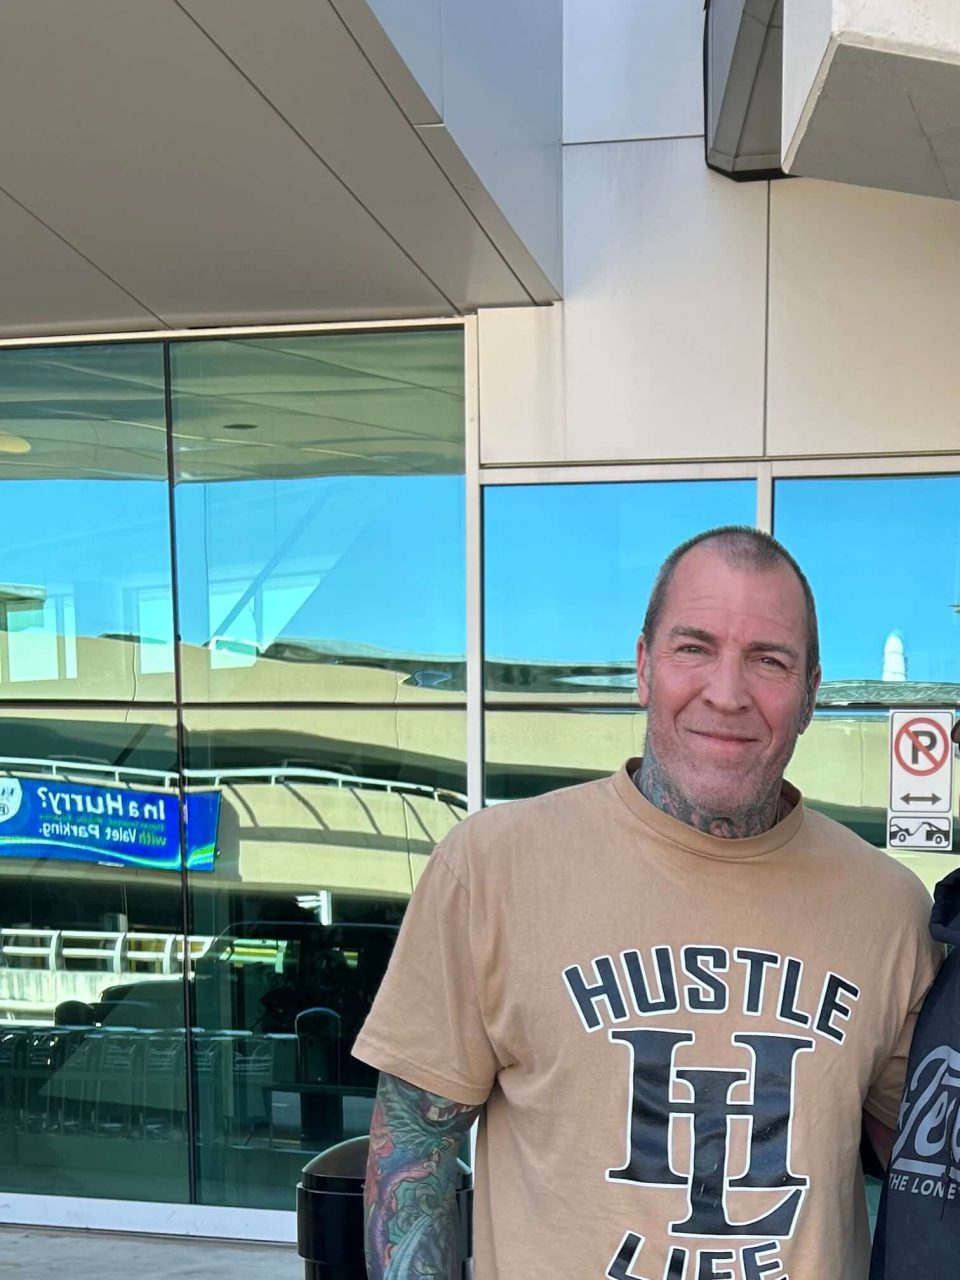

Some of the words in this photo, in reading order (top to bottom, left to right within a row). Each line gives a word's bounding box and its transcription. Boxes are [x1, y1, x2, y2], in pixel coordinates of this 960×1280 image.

[562, 945, 860, 1045] HUSTLE
[889, 1172, 907, 1192] THE
[911, 1177, 957, 1200] LONE
